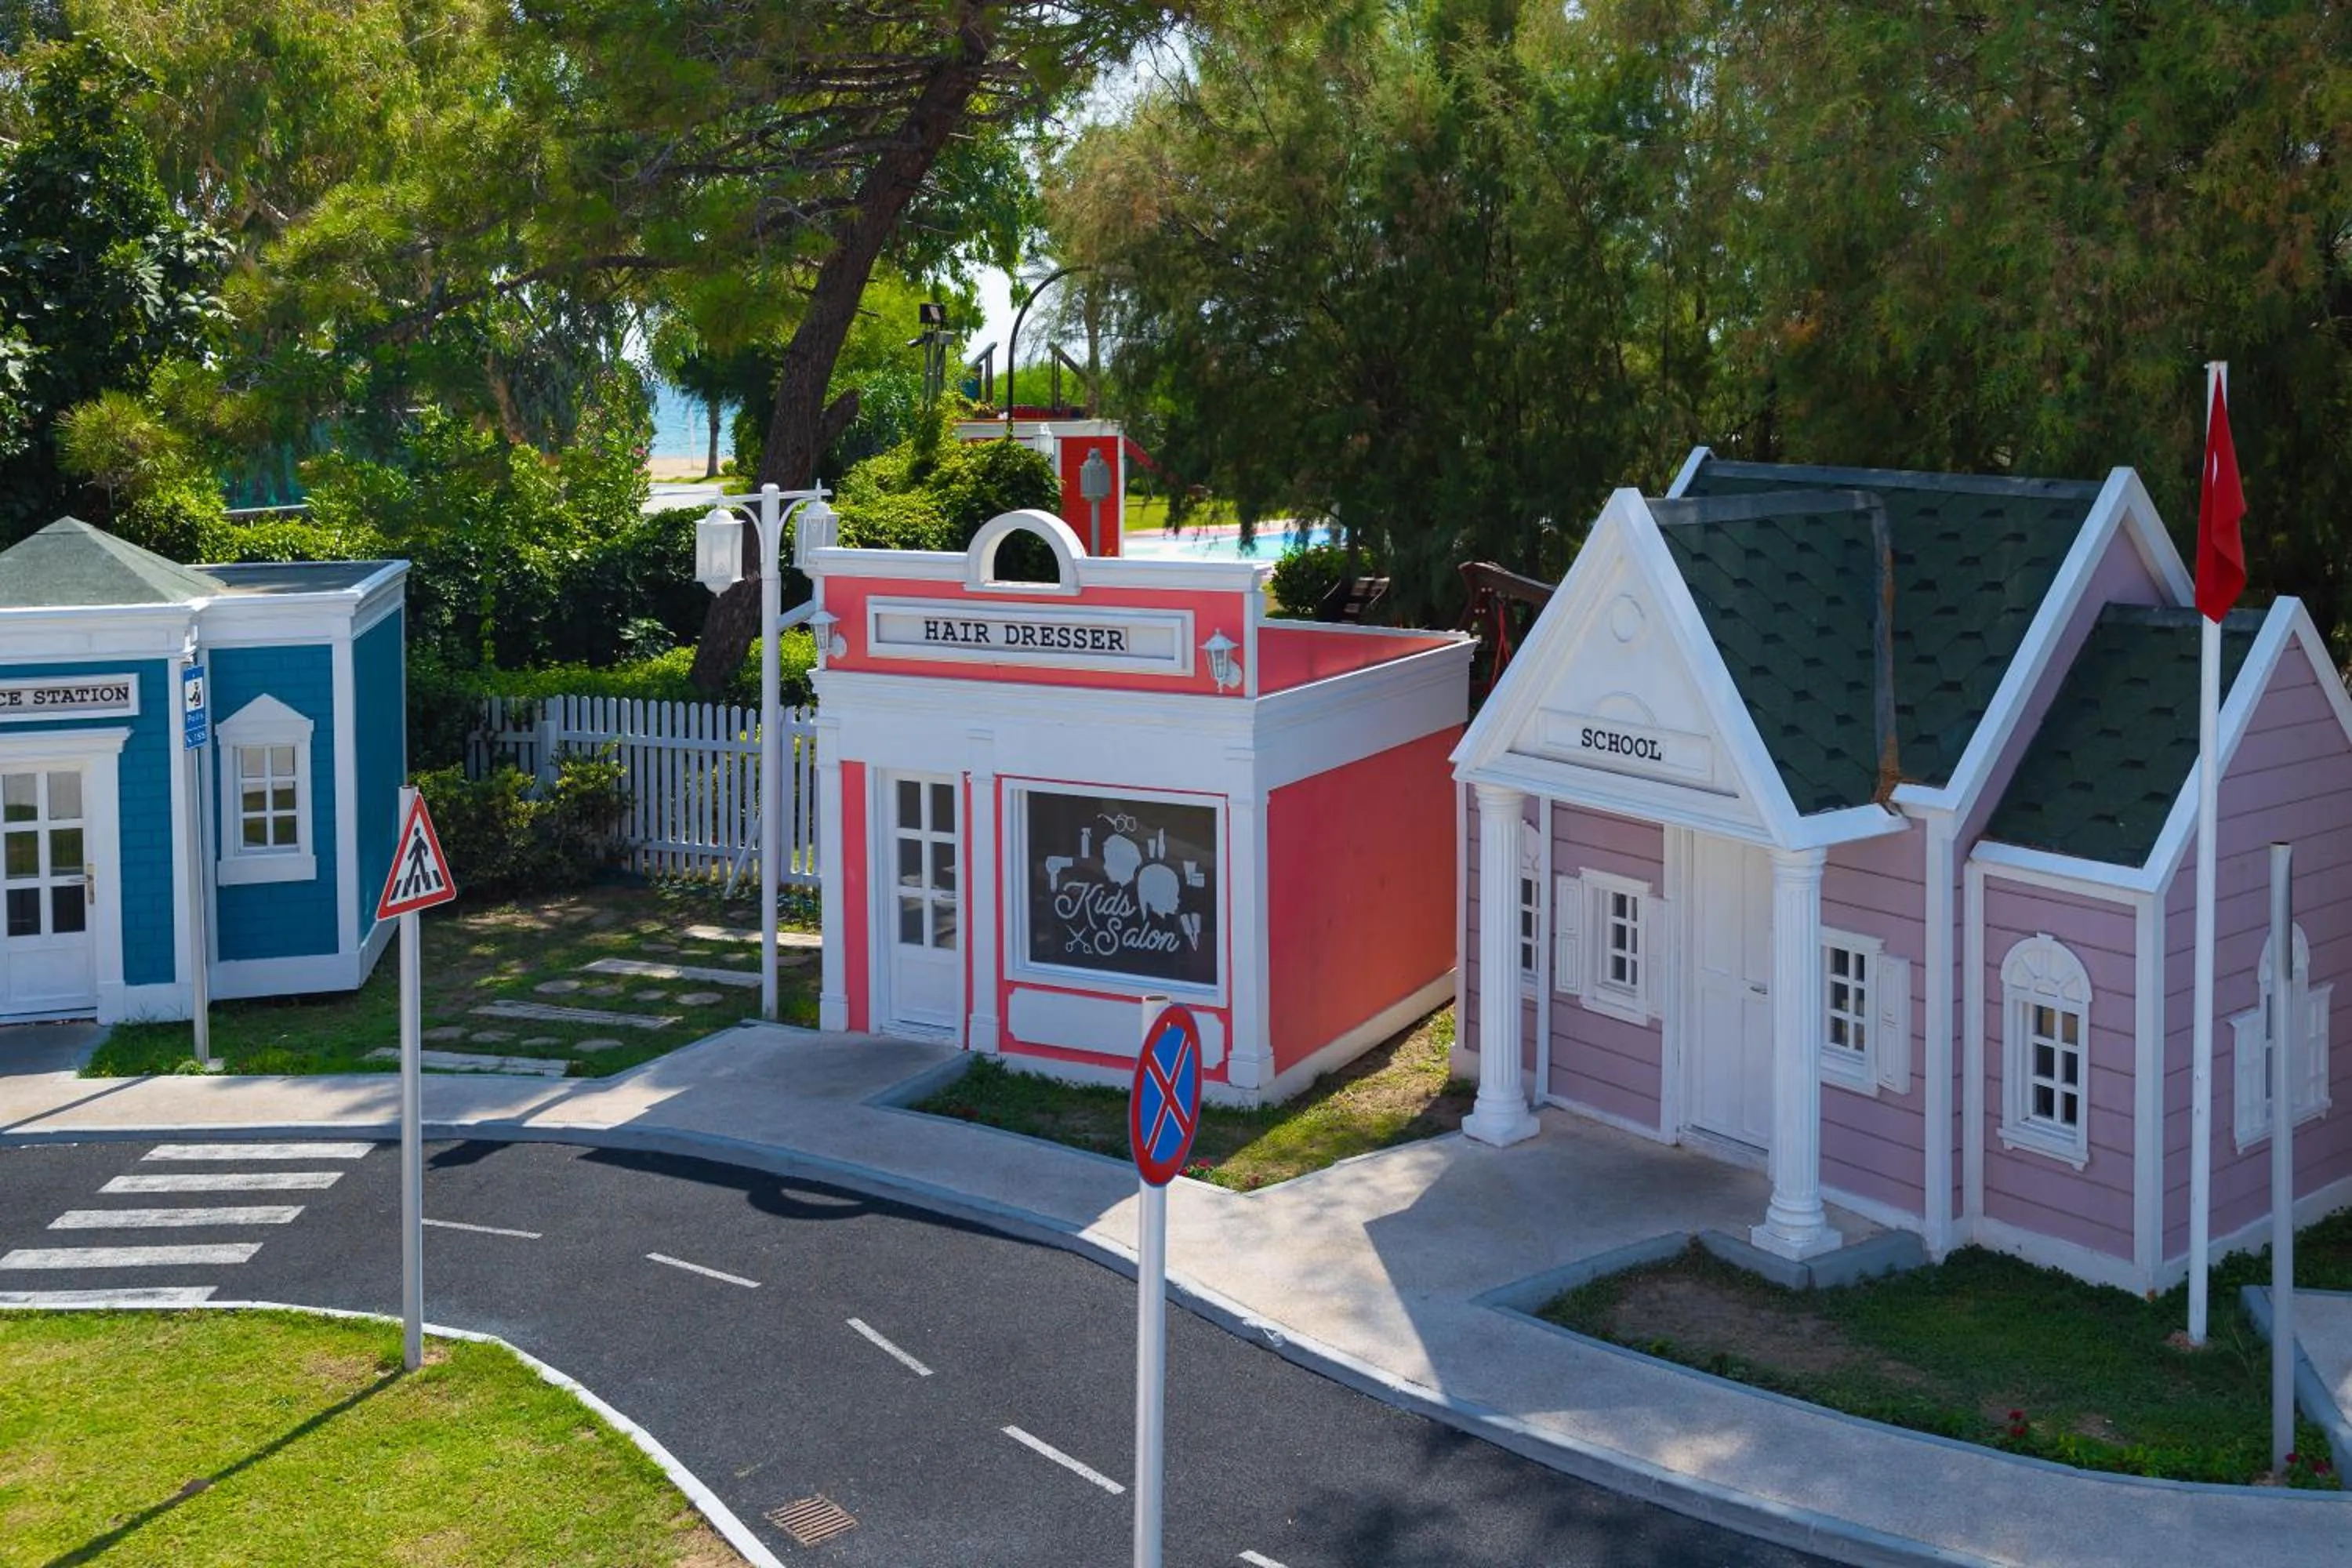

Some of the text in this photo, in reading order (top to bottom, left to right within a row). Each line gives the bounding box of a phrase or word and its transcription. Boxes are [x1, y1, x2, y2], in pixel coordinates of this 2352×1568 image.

[924, 620, 1126, 652] HAIR DRESSER
[34, 686, 129, 706] STATION
[1581, 728, 1662, 761] SCHOOL
[1054, 882, 1136, 930] Kids
[1094, 916, 1180, 956] Salon
